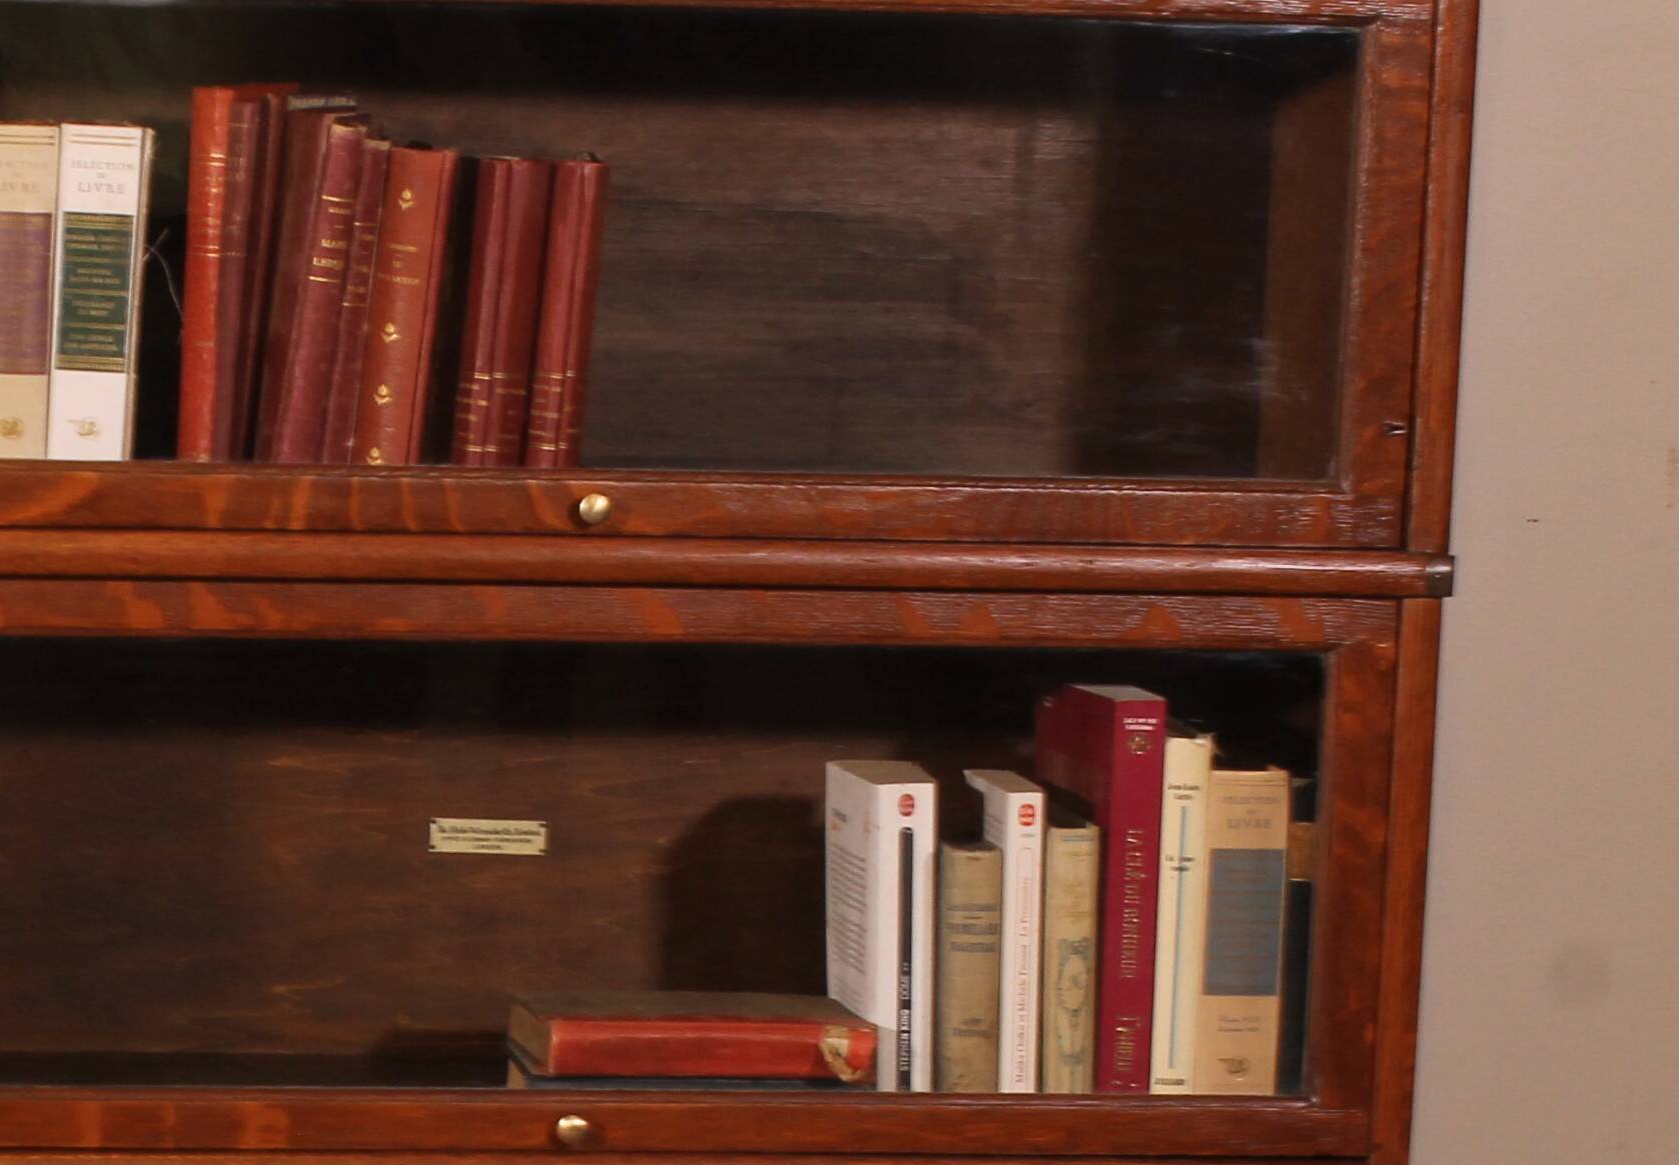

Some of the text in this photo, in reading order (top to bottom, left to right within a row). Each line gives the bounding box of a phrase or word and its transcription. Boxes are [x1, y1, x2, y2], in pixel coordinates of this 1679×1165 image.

[77, 182, 126, 195] LIVRE
[899, 1008, 911, 1031] KING
[898, 1033, 911, 1072] STEPHEN
